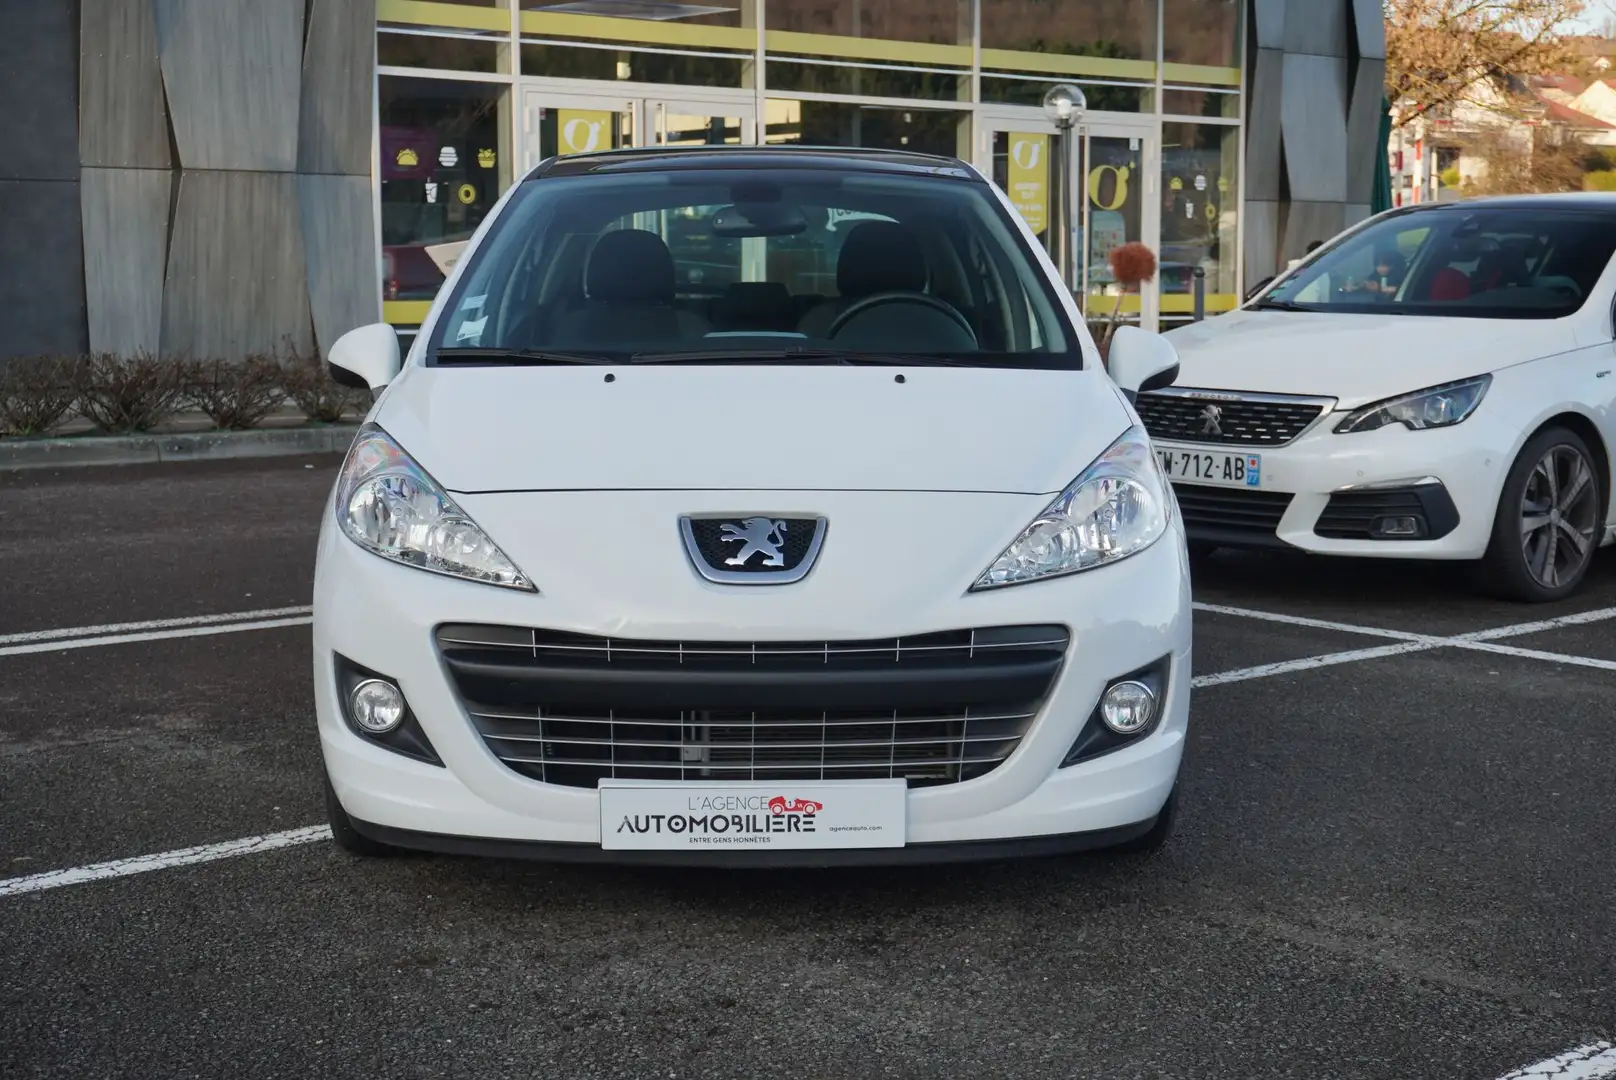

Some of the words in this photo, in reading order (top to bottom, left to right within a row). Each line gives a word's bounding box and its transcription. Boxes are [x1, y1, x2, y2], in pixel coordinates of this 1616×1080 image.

[1157, 450, 1245, 481] W-712-AB
[829, 825, 883, 833] agenceauto.com
[689, 836, 711, 844] ENTRE
[712, 836, 732, 844] GENS
